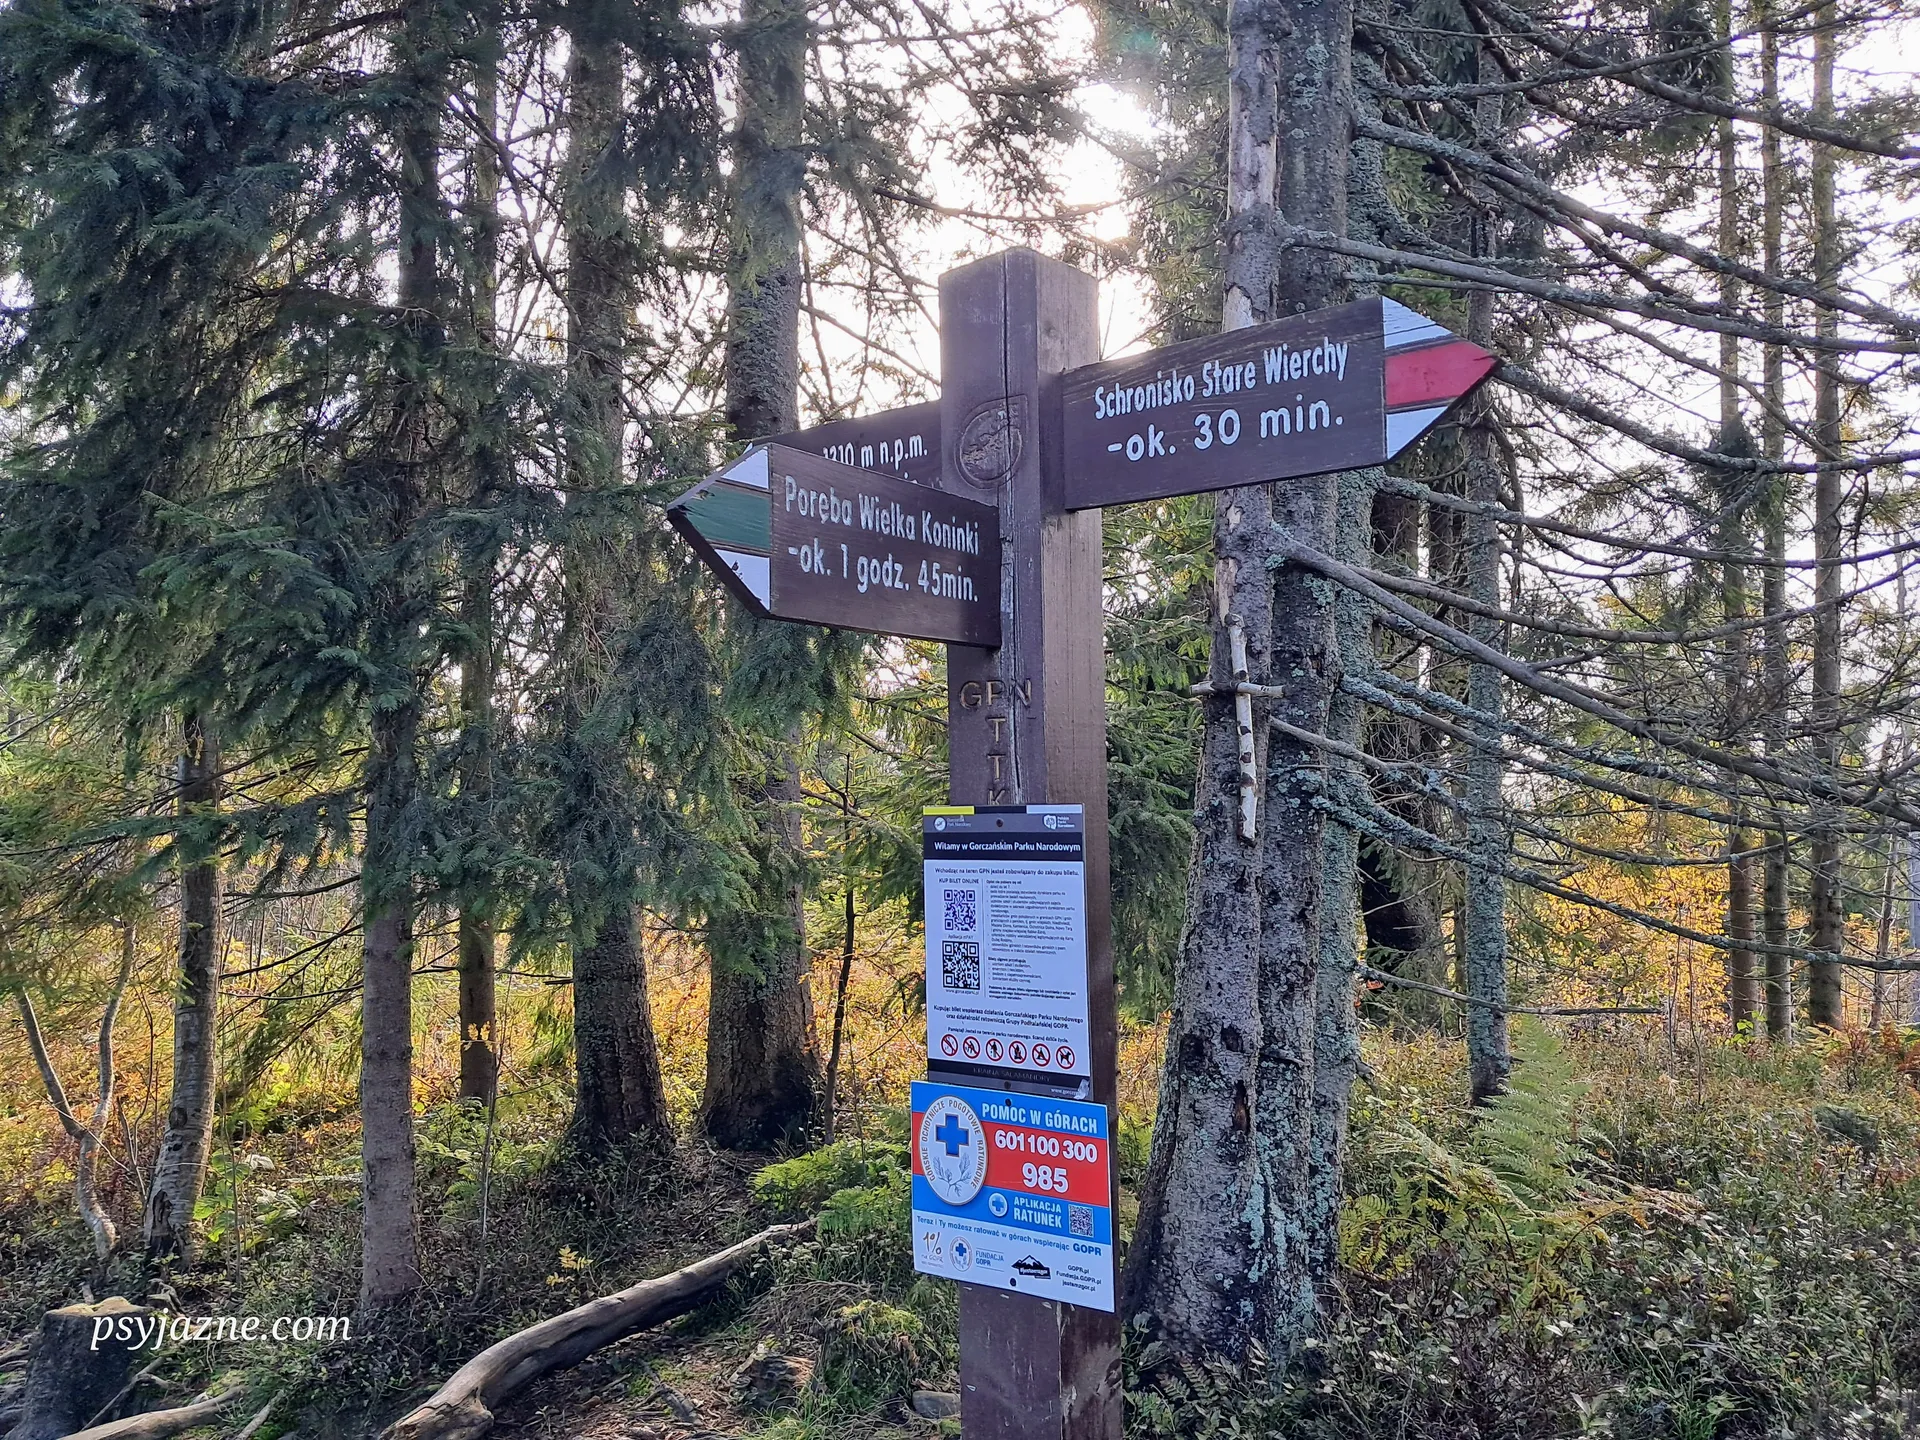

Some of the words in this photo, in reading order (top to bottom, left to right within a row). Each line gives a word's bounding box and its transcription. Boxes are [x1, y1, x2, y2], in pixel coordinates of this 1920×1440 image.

[1094, 370, 1194, 420] Schronisko
[1202, 360, 1256, 398] Stare
[1264, 336, 1348, 384] Wierchy
[1108, 424, 1176, 462] -ok.
[1194, 409, 1240, 450] 30
[1260, 395, 1344, 438] min.
[861, 444, 874, 468] m
[880, 434, 928, 470] n.p.m.
[786, 476, 852, 526] Poręba
[859, 493, 915, 541] Wielka
[922, 510, 980, 555] Koninki
[788, 538, 830, 576] -ok.
[840, 544, 848, 579] 1
[858, 554, 909, 593] godz.
[918, 560, 978, 602] 45min.
[960, 678, 1032, 710] GPN
[934, 842, 960, 851] Witamy
[969, 842, 1012, 850] Gorczańskim
[1014, 842, 1034, 850] Parku
[1036, 842, 1080, 852] Narodowym
[1004, 1010, 1037, 1019] Gorczańskiego
[1053, 1015, 1083, 1023] Narodowego
[1021, 1020, 1052, 1029] Podhalańskiej
[973, 1067, 999, 1076] KRAINA
[1002, 1071, 1050, 1082] SALAMANDRY
[922, 1100, 945, 1142] OCHOTNICZE
[949, 1100, 981, 1135] POGOTOWIE
[982, 1103, 1026, 1123] POMOC
[1030, 1110, 1041, 1125] W
[1045, 1110, 1097, 1134] GÓRACH
[995, 1130, 1025, 1151] 601
[1028, 1135, 1060, 1157] 100
[1063, 1140, 1097, 1163] 300
[922, 1147, 935, 1181] GÓRSKIE
[971, 1140, 984, 1189] RATUNKOWE
[1022, 1162, 1068, 1193] 985
[1014, 1196, 1061, 1213] APLIKACJA
[1014, 1208, 1062, 1228] RATUNEK
[917, 1216, 933, 1225] Teraz
[938, 1220, 946, 1229] Ty
[948, 1222, 972, 1232] możesz
[974, 1227, 1000, 1236] ratować
[1009, 1233, 1032, 1242] górach
[1034, 1237, 1069, 1251] wspierając
[1073, 1243, 1102, 1256] GOPR
[923, 1232, 942, 1255] 1%
[976, 1250, 1004, 1261] FUNDACJA
[976, 1258, 991, 1266] GOPR
[1068, 1265, 1089, 1274] GOPR.pl
